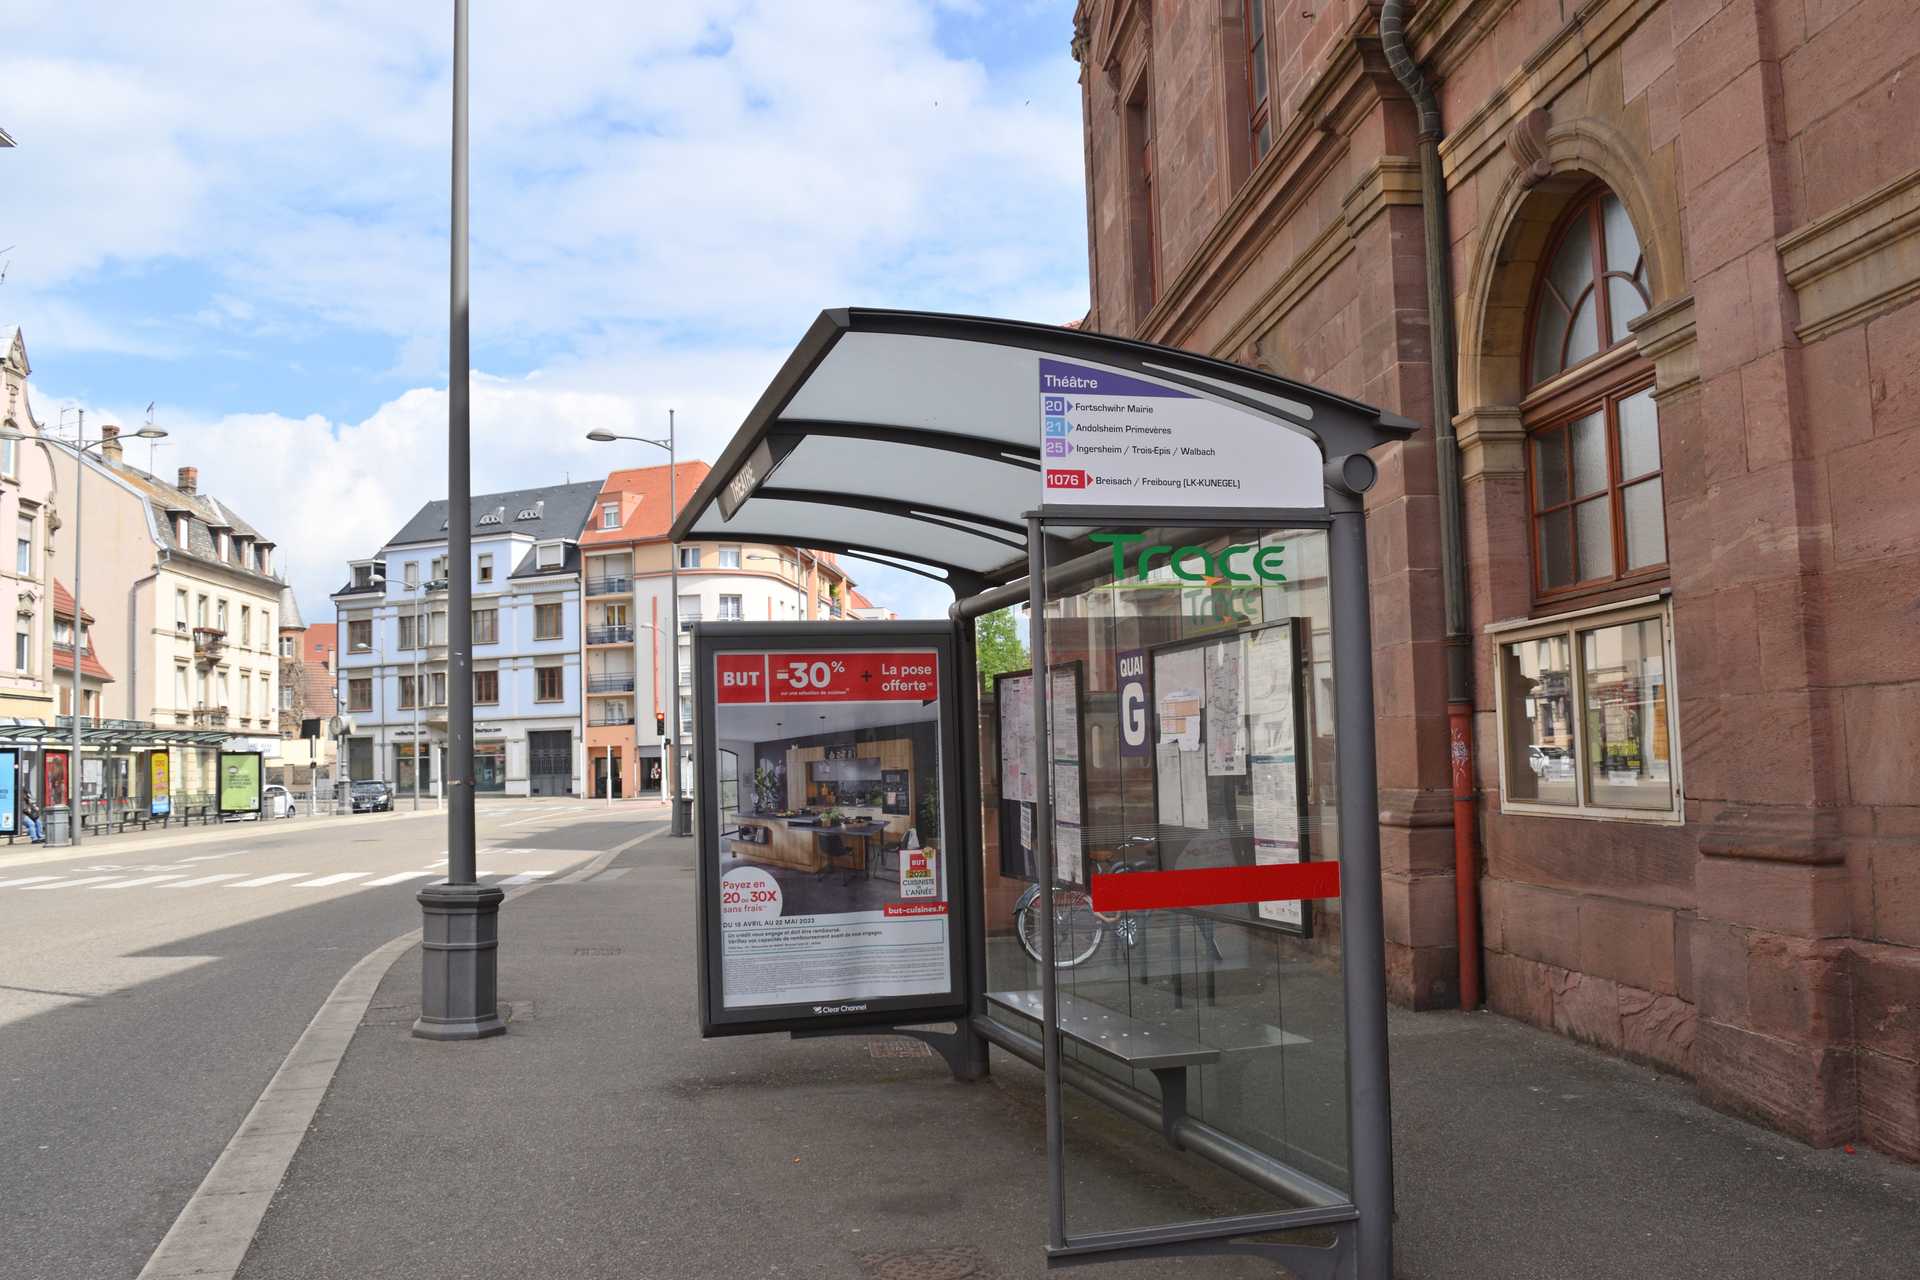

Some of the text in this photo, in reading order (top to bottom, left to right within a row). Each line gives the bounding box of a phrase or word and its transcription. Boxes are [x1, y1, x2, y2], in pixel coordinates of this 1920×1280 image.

[1044, 375, 1098, 389] Théâtre
[1046, 400, 1154, 414] 20 Fortschwihr Mairie
[1046, 421, 1172, 435] 21 Andolsheim Primevères
[1046, 442, 1064, 454] 25
[1076, 444, 1122, 455] Ingersheim
[1132, 446, 1171, 456] Trois-Epis
[1180, 447, 1216, 457] Walbach
[1047, 474, 1079, 486] 1076
[1096, 477, 1132, 486] Breisach
[1142, 478, 1182, 489] Freibourg
[881, 663, 932, 677] La pose
[1120, 656, 1144, 678] QUAI
[723, 671, 760, 686] BUT
[1122, 682, 1146, 746] G
[722, 881, 751, 890] Payez
[723, 892, 741, 904] 20
[723, 905, 742, 914] sans
[888, 905, 945, 914] but-cuisines.fr
[841, 1003, 867, 1012] Channel
